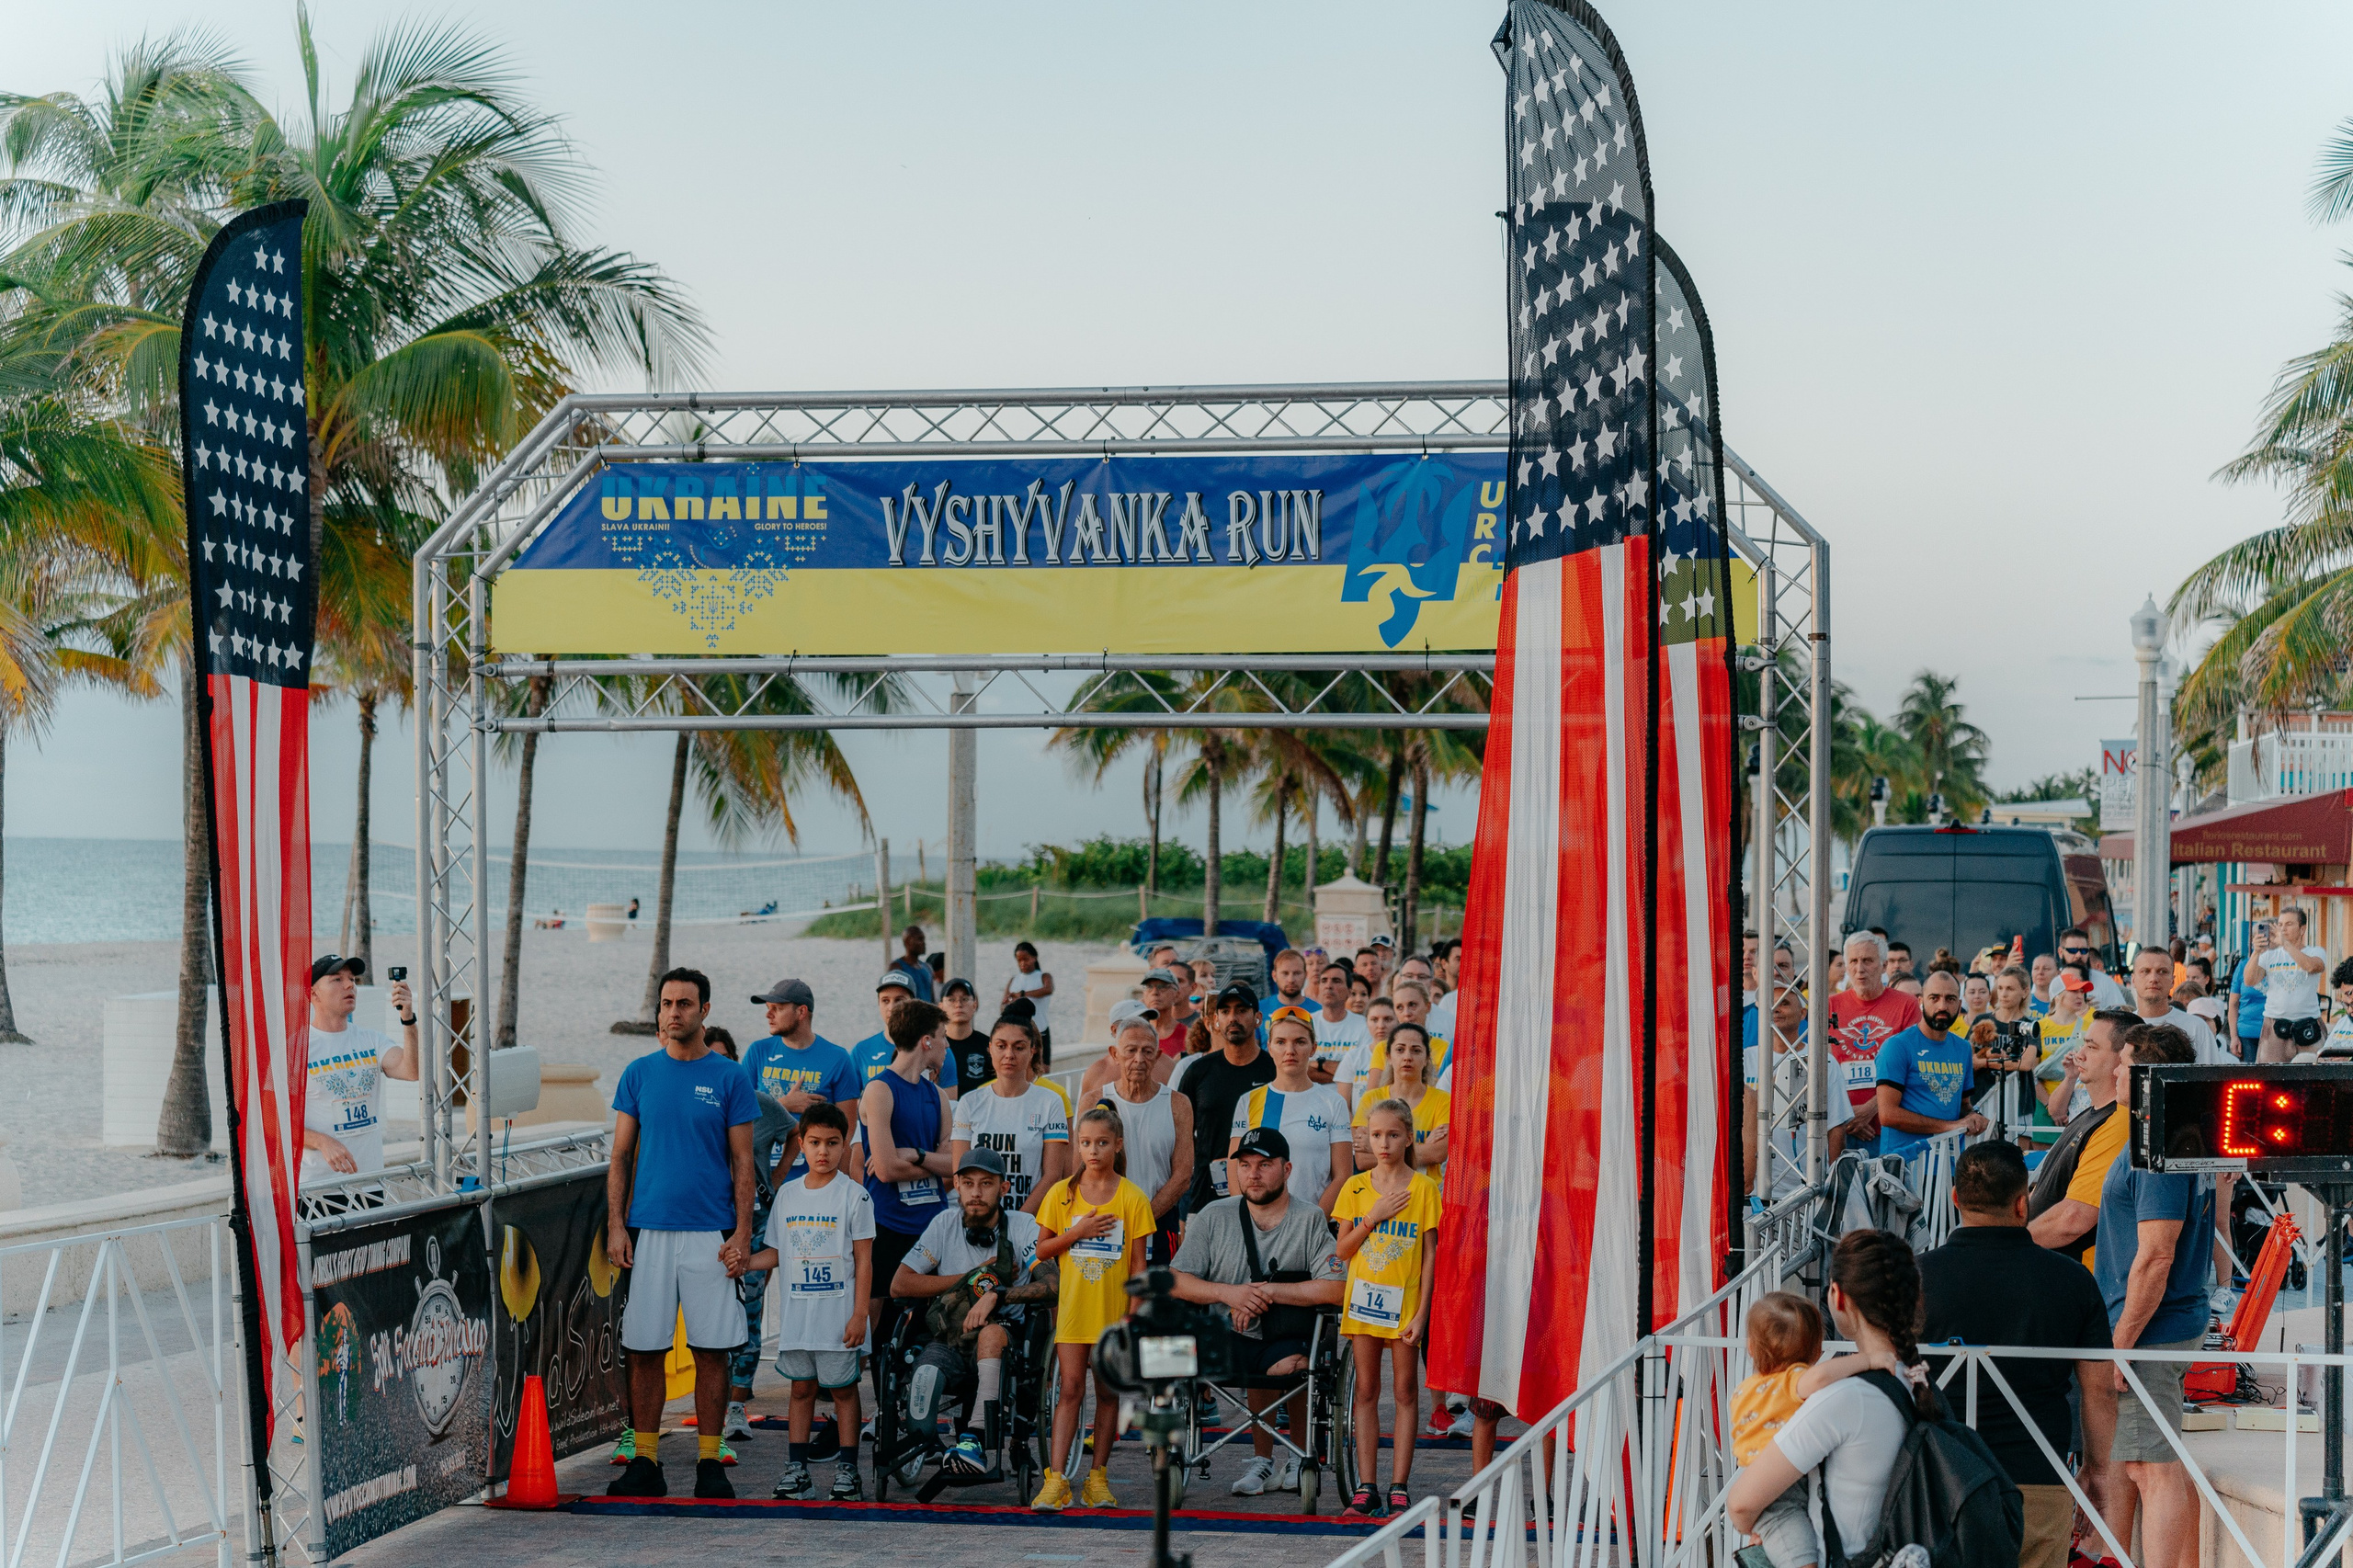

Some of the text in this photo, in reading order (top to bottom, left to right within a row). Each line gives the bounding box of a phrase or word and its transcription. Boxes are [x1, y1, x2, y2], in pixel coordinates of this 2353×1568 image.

[601, 475, 827, 521] UKRAINE
[601, 523, 670, 531] SLAVA UKRAINI!
[755, 522, 781, 530] GLORY
[880, 477, 1324, 570] VYSHYVANKA RUN
[2173, 842, 2327, 858] Italian Restaurant
[308, 1049, 378, 1075] UKRAINE
[1917, 1060, 1964, 1075] UKRAINE
[762, 1066, 823, 1085] UKRAINE
[1850, 1066, 1871, 1078] 118
[695, 1085, 713, 1094] NSU
[345, 1104, 369, 1121] 148
[979, 1132, 1016, 1152] RUN
[1001, 1153, 1022, 1174] TH
[786, 1213, 838, 1228] UKRAINE
[803, 1267, 832, 1283] 145
[1367, 1291, 1384, 1310] 14
